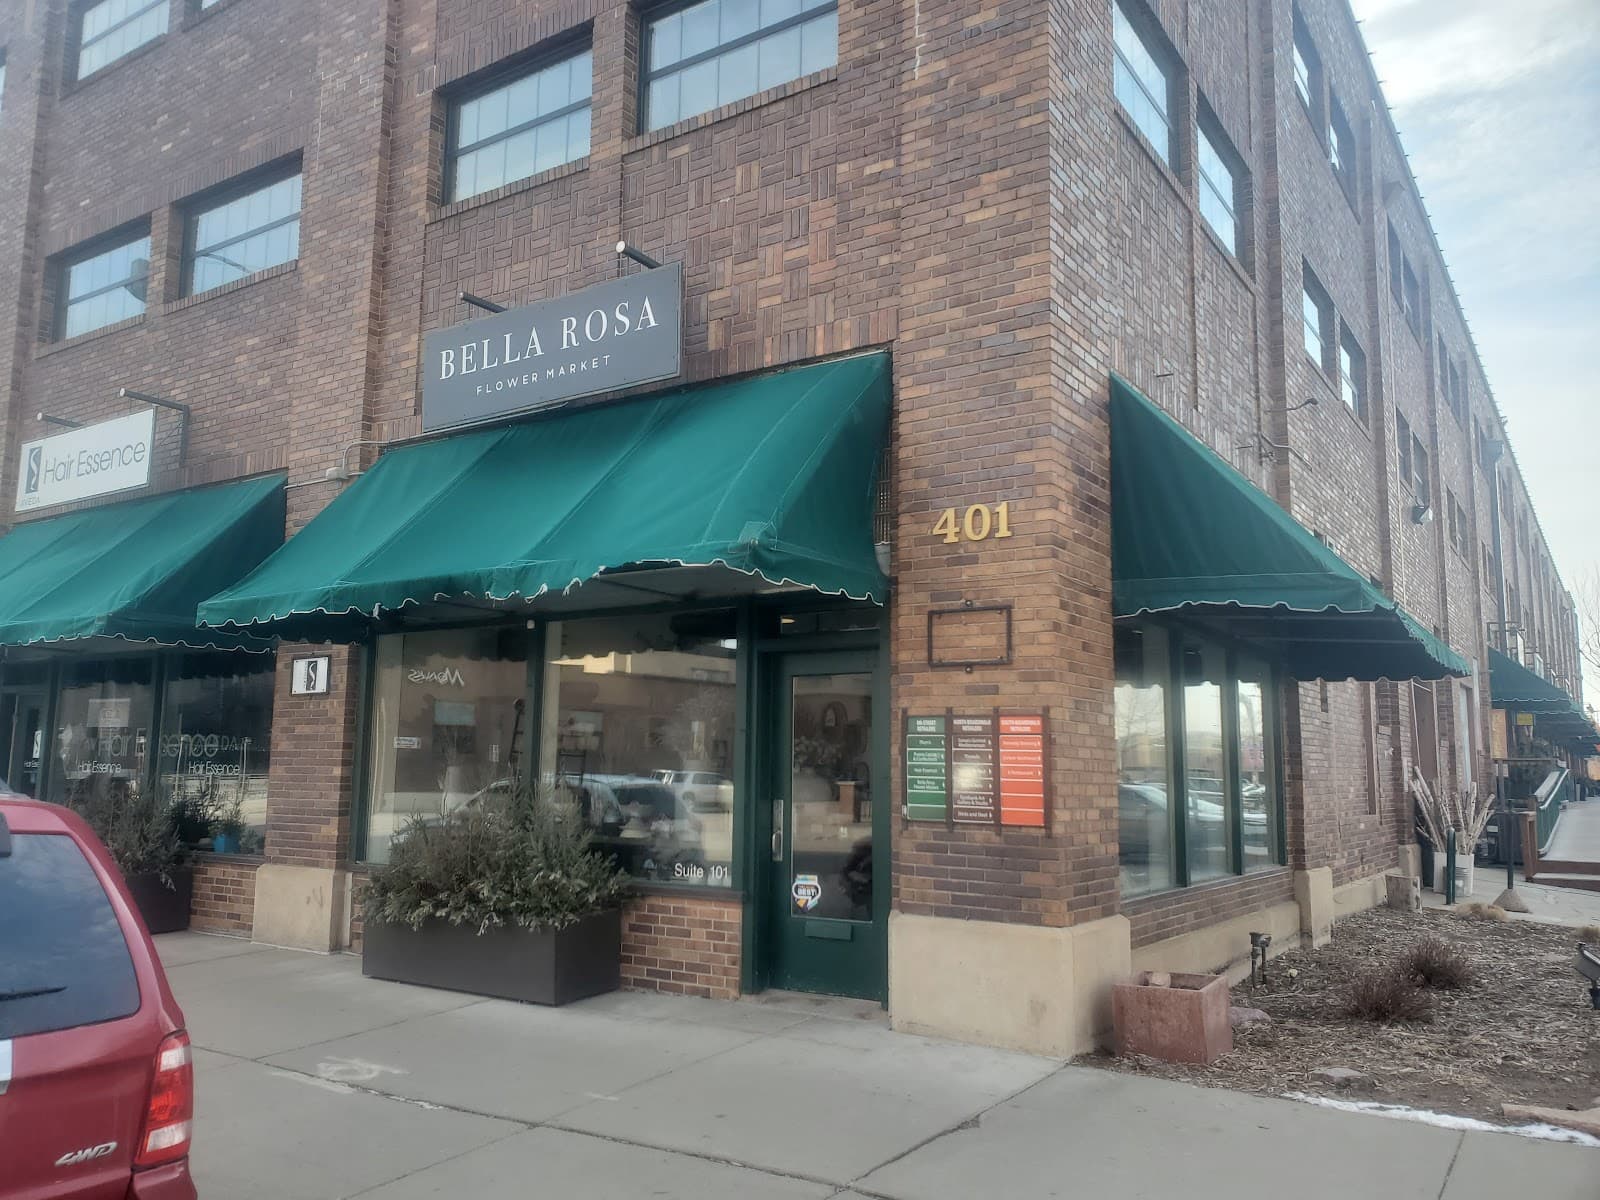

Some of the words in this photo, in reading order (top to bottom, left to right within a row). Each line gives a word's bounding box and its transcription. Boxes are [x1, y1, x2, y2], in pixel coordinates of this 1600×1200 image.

[439, 326, 545, 380] BELLA
[559, 295, 660, 350] ROSA
[475, 374, 539, 396] FLOWER
[546, 354, 612, 379] MARKET
[43, 453, 74, 484] Hair
[76, 441, 146, 477] Essence
[932, 500, 1013, 544] 401
[78, 760, 91, 774] Hair
[92, 760, 122, 774] Essence
[188, 760, 206, 774] Hair
[207, 760, 241, 775] Essence
[674, 862, 704, 879] Suite
[710, 864, 728, 880] 101
[55, 1141, 118, 1167] 4WD
